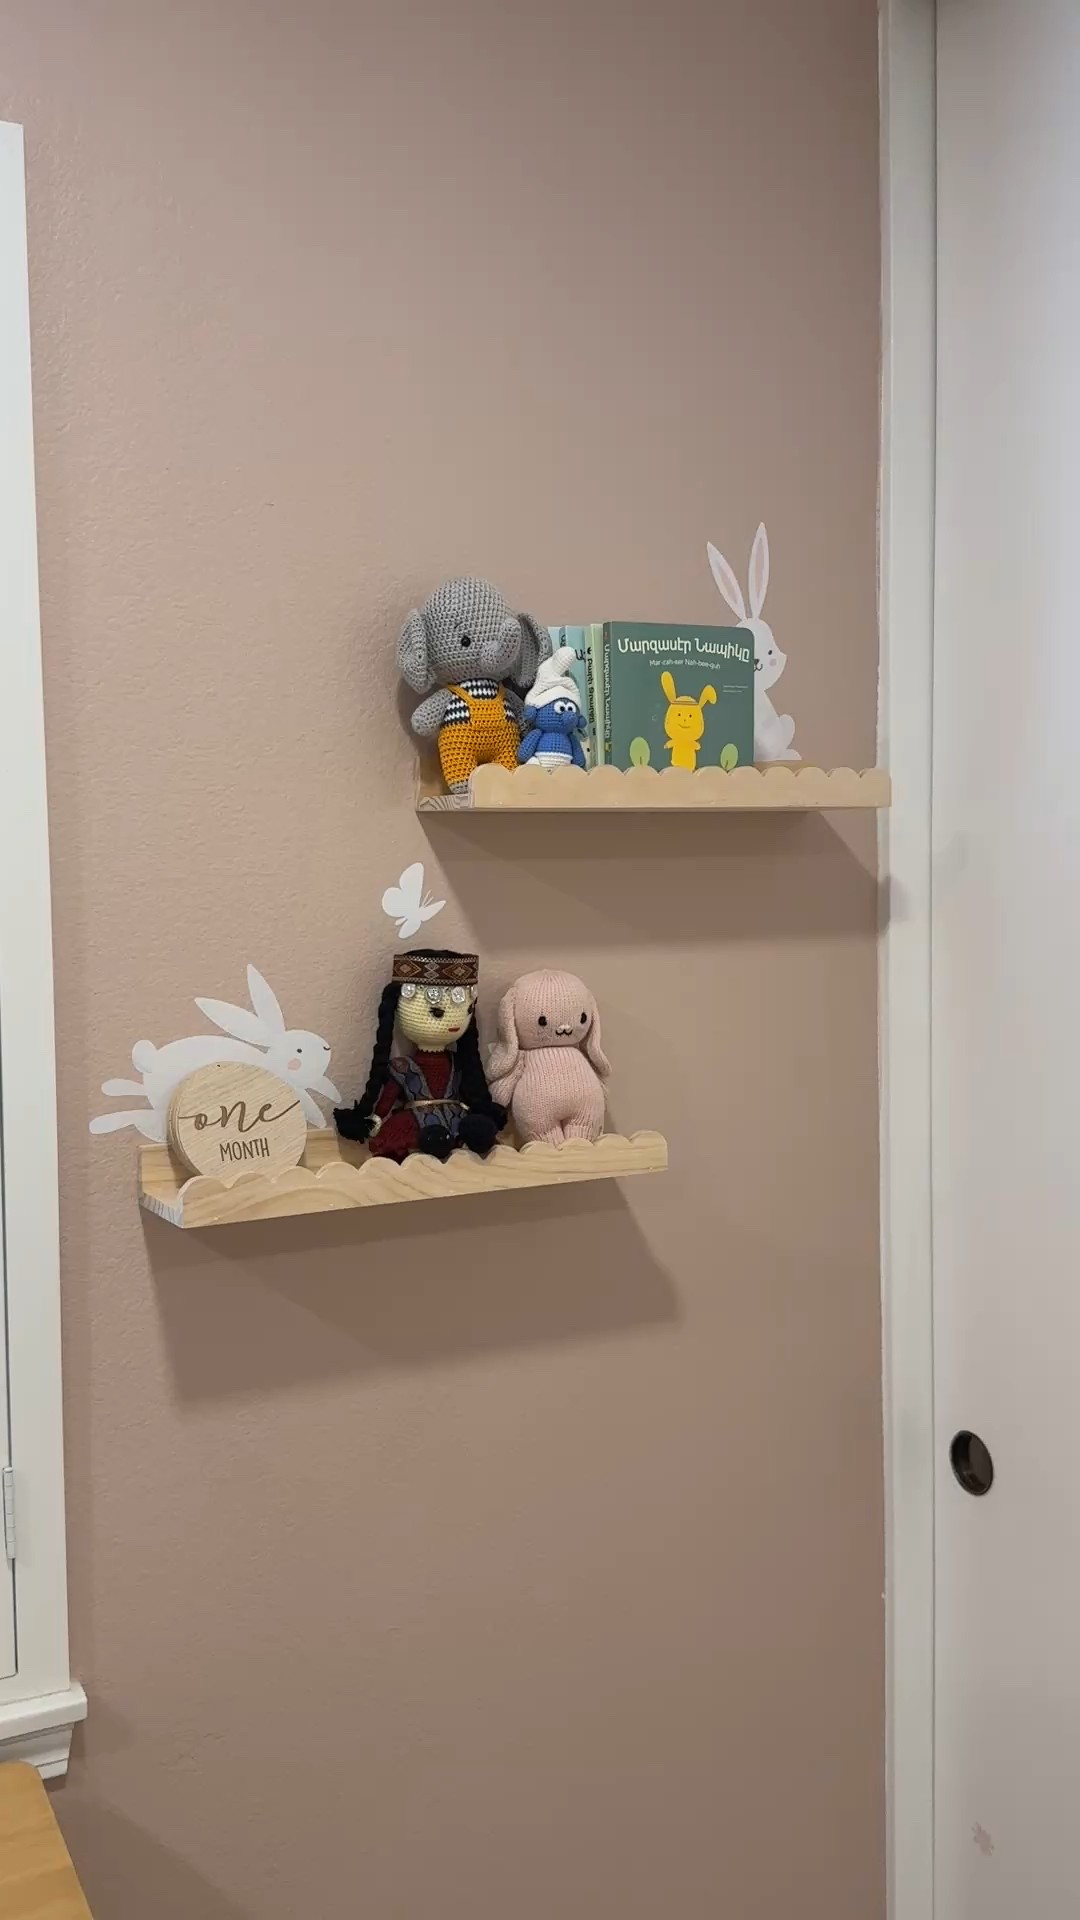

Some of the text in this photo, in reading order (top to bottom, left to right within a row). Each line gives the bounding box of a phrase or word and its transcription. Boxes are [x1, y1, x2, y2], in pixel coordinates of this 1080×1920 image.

[617, 636, 750, 663] Մարզասէր Նապիկը
[178, 1101, 300, 1133] one
[220, 1137, 270, 1162] MONTH
